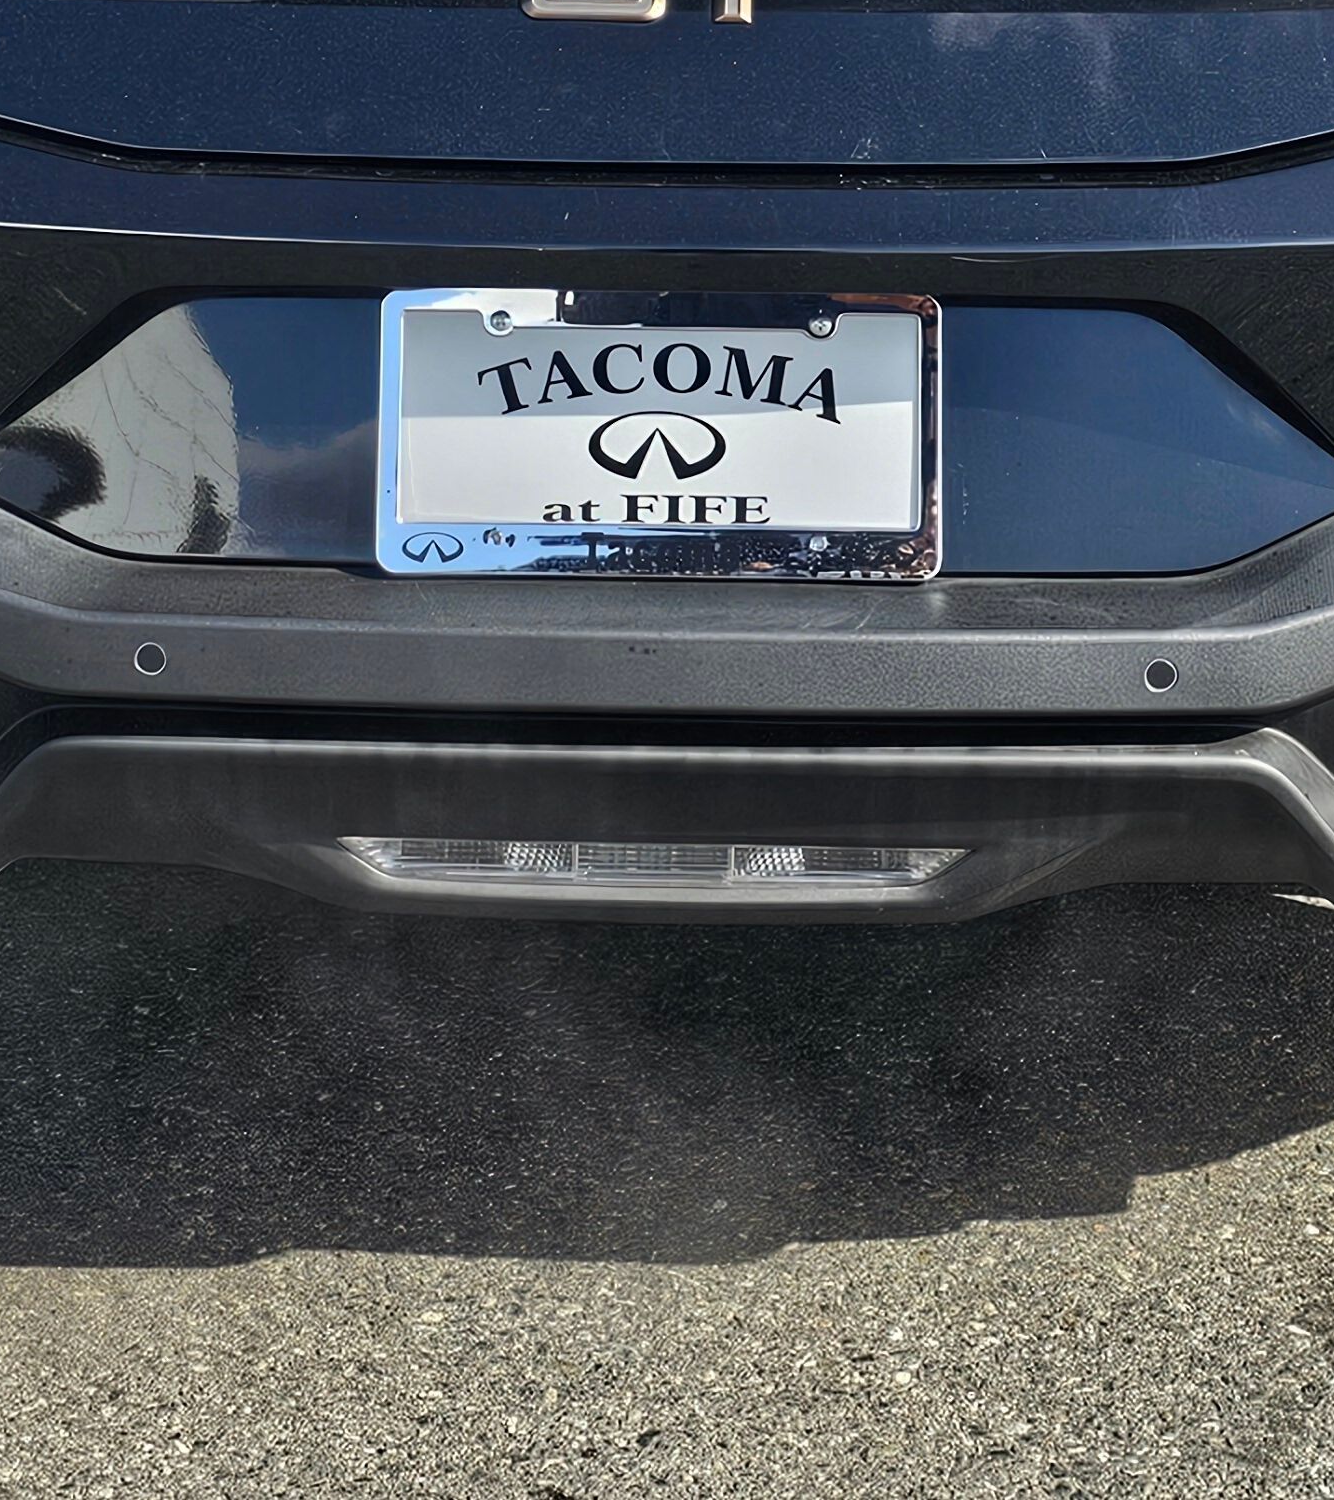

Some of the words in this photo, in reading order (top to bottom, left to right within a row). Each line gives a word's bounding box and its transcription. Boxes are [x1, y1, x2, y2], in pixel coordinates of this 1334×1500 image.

[477, 342, 841, 425] TACOMA
[542, 500, 601, 522] at
[620, 494, 771, 524] FIFE
